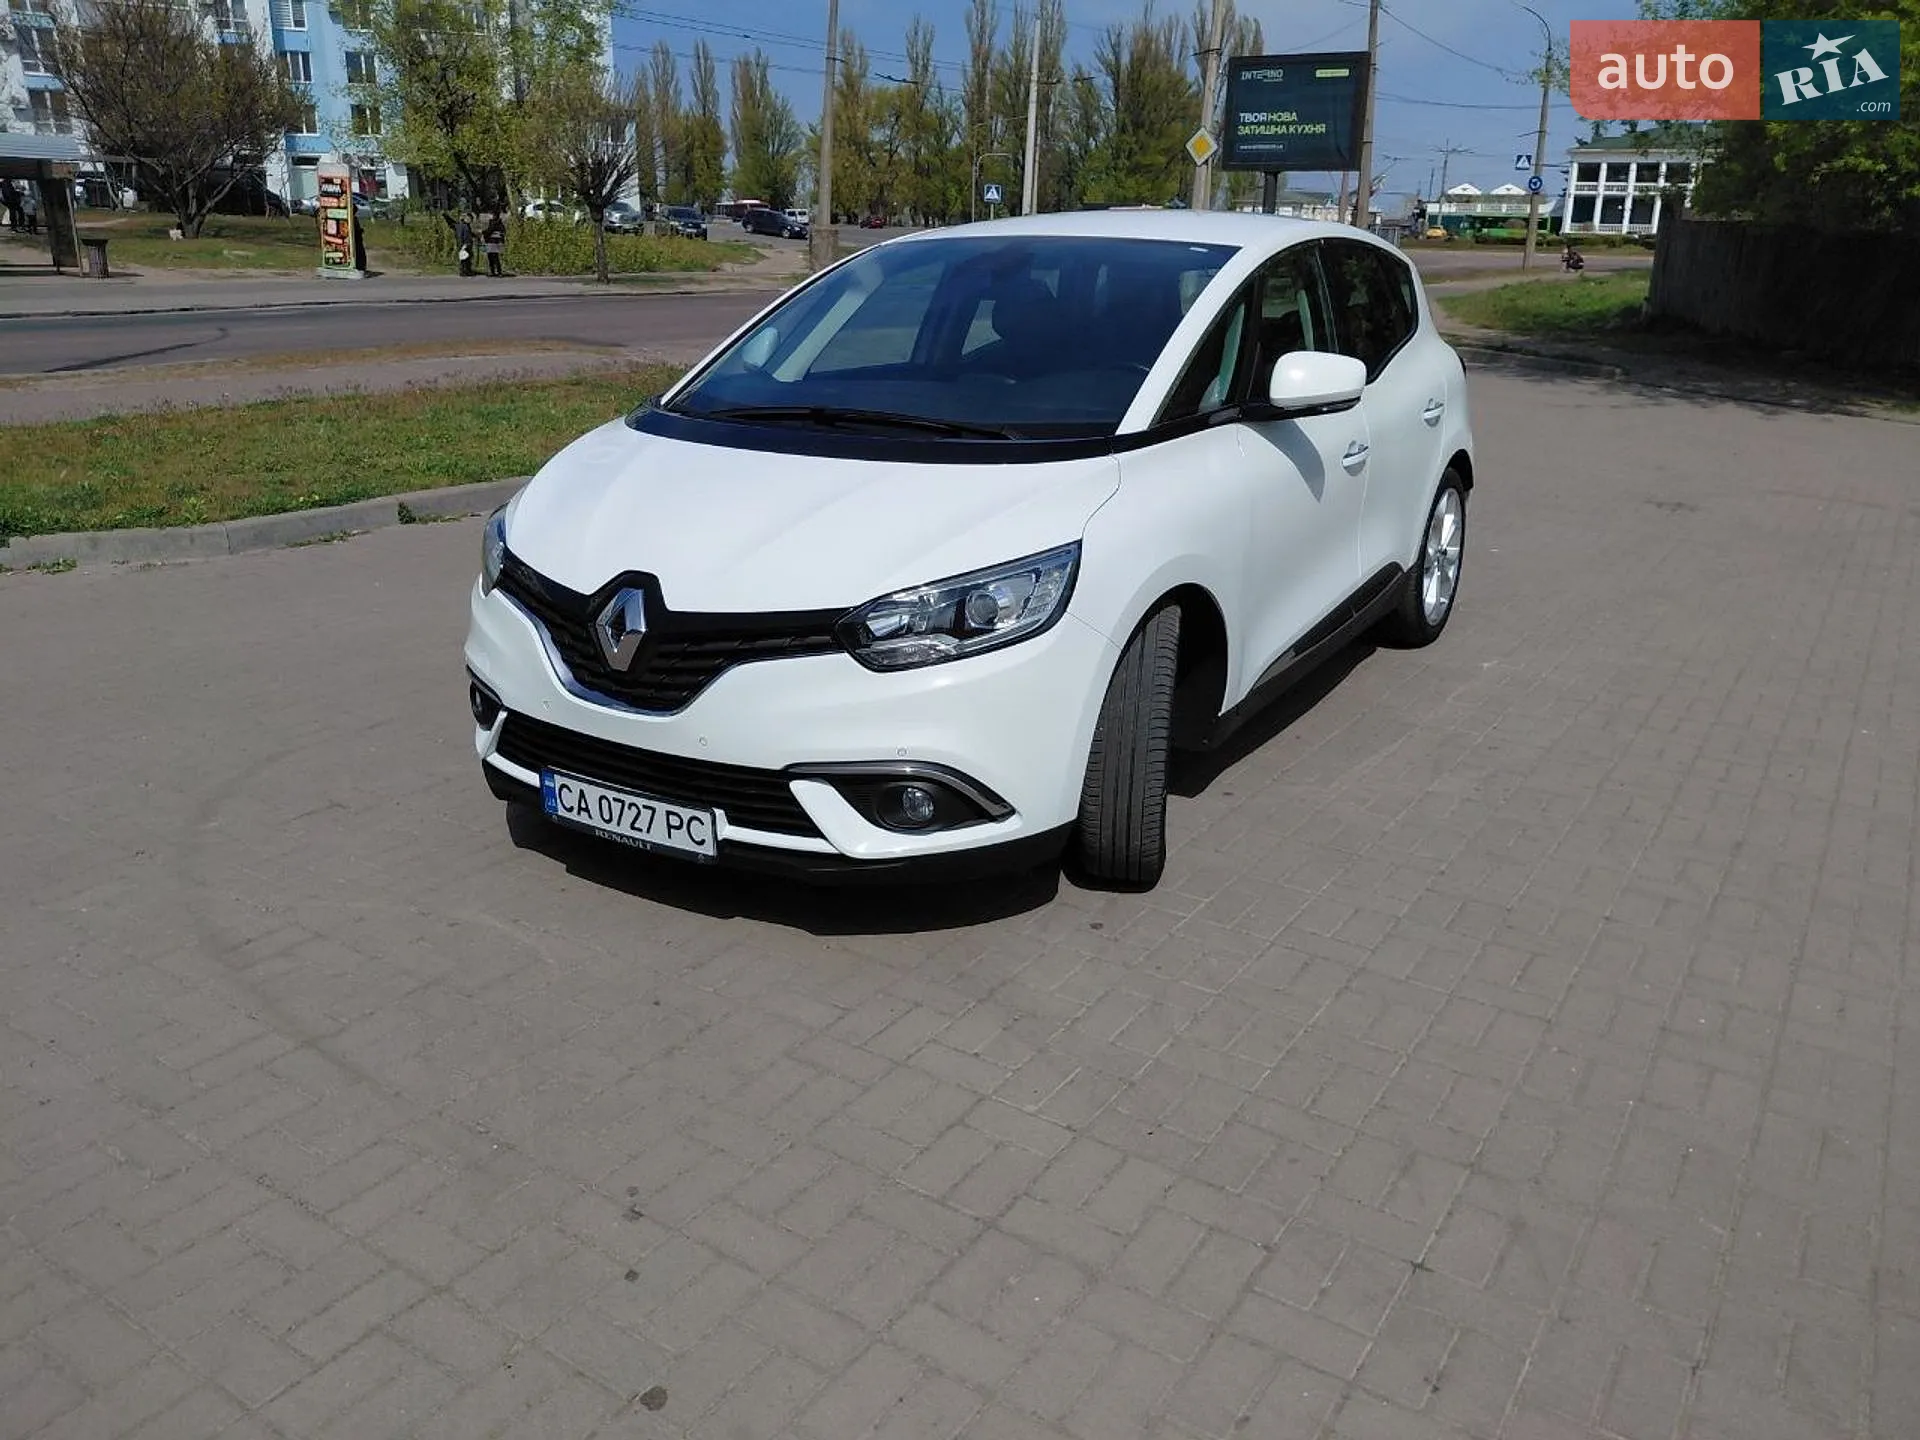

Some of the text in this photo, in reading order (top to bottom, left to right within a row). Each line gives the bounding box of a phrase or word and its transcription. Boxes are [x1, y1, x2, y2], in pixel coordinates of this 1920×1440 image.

[1240, 112, 1298, 123] ТВОЯ НОВА
[1237, 123, 1326, 135] ЗАТИШНА КУХНЯ
[558, 783, 706, 846] CA 0727 PC
